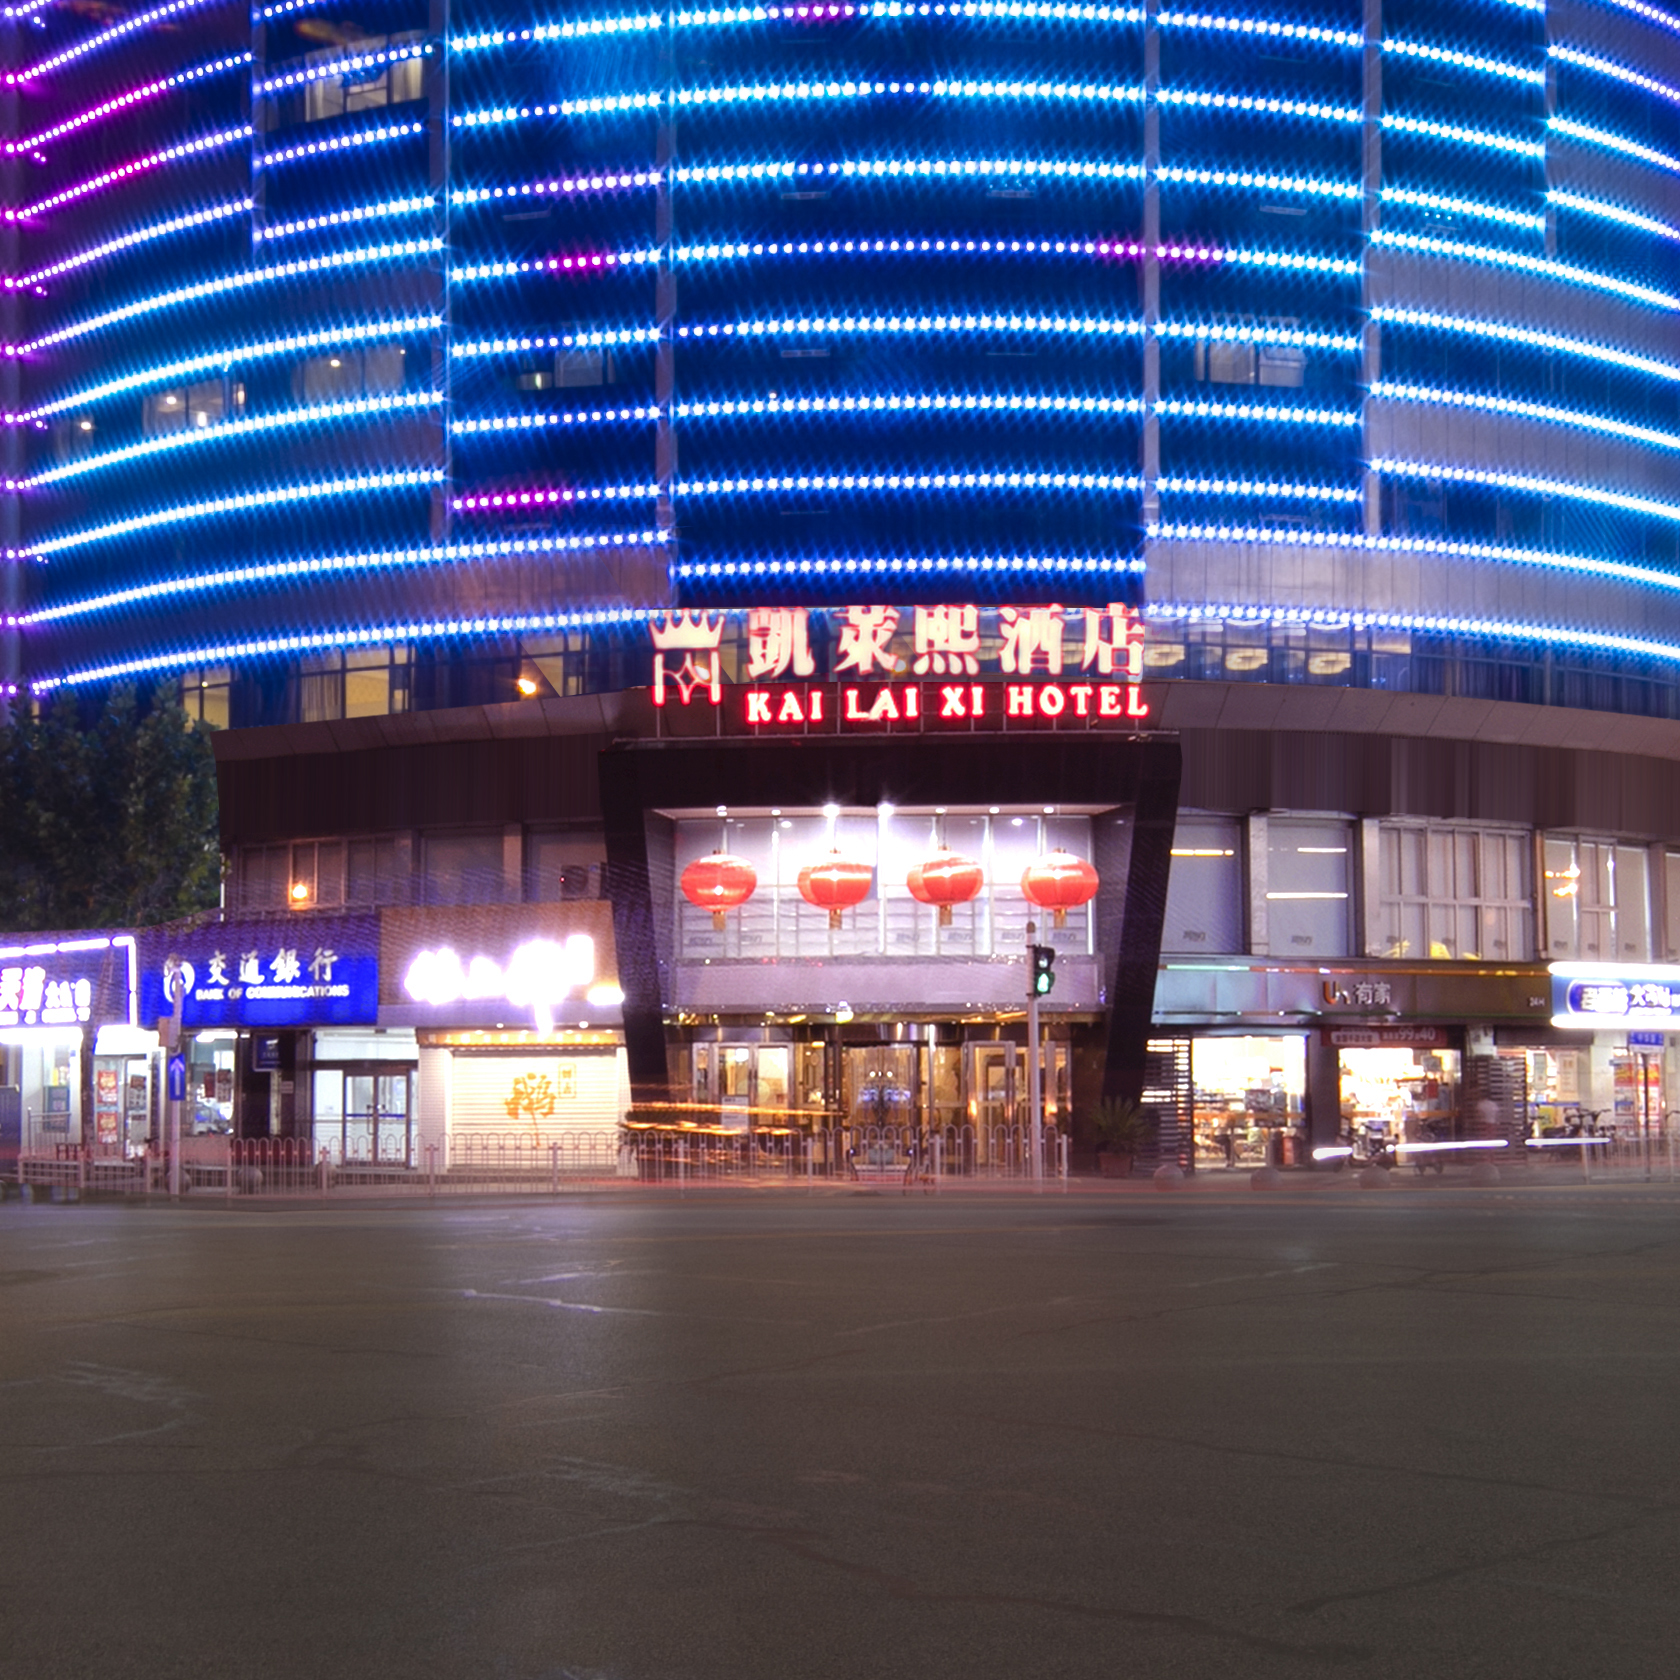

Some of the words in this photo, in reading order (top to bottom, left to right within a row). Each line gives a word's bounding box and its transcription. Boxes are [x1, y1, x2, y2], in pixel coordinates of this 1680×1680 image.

[746, 690, 823, 723] KAI
[844, 687, 920, 722] LAI
[940, 686, 984, 717] XI
[1006, 685, 1150, 718] HOTEL
[206, 947, 339, 986] 交通銀行
[195, 988, 224, 1001] BANK
[227, 986, 244, 1000] OF
[1354, 981, 1391, 1005] 有家
[1529, 996, 1545, 1007] 24H
